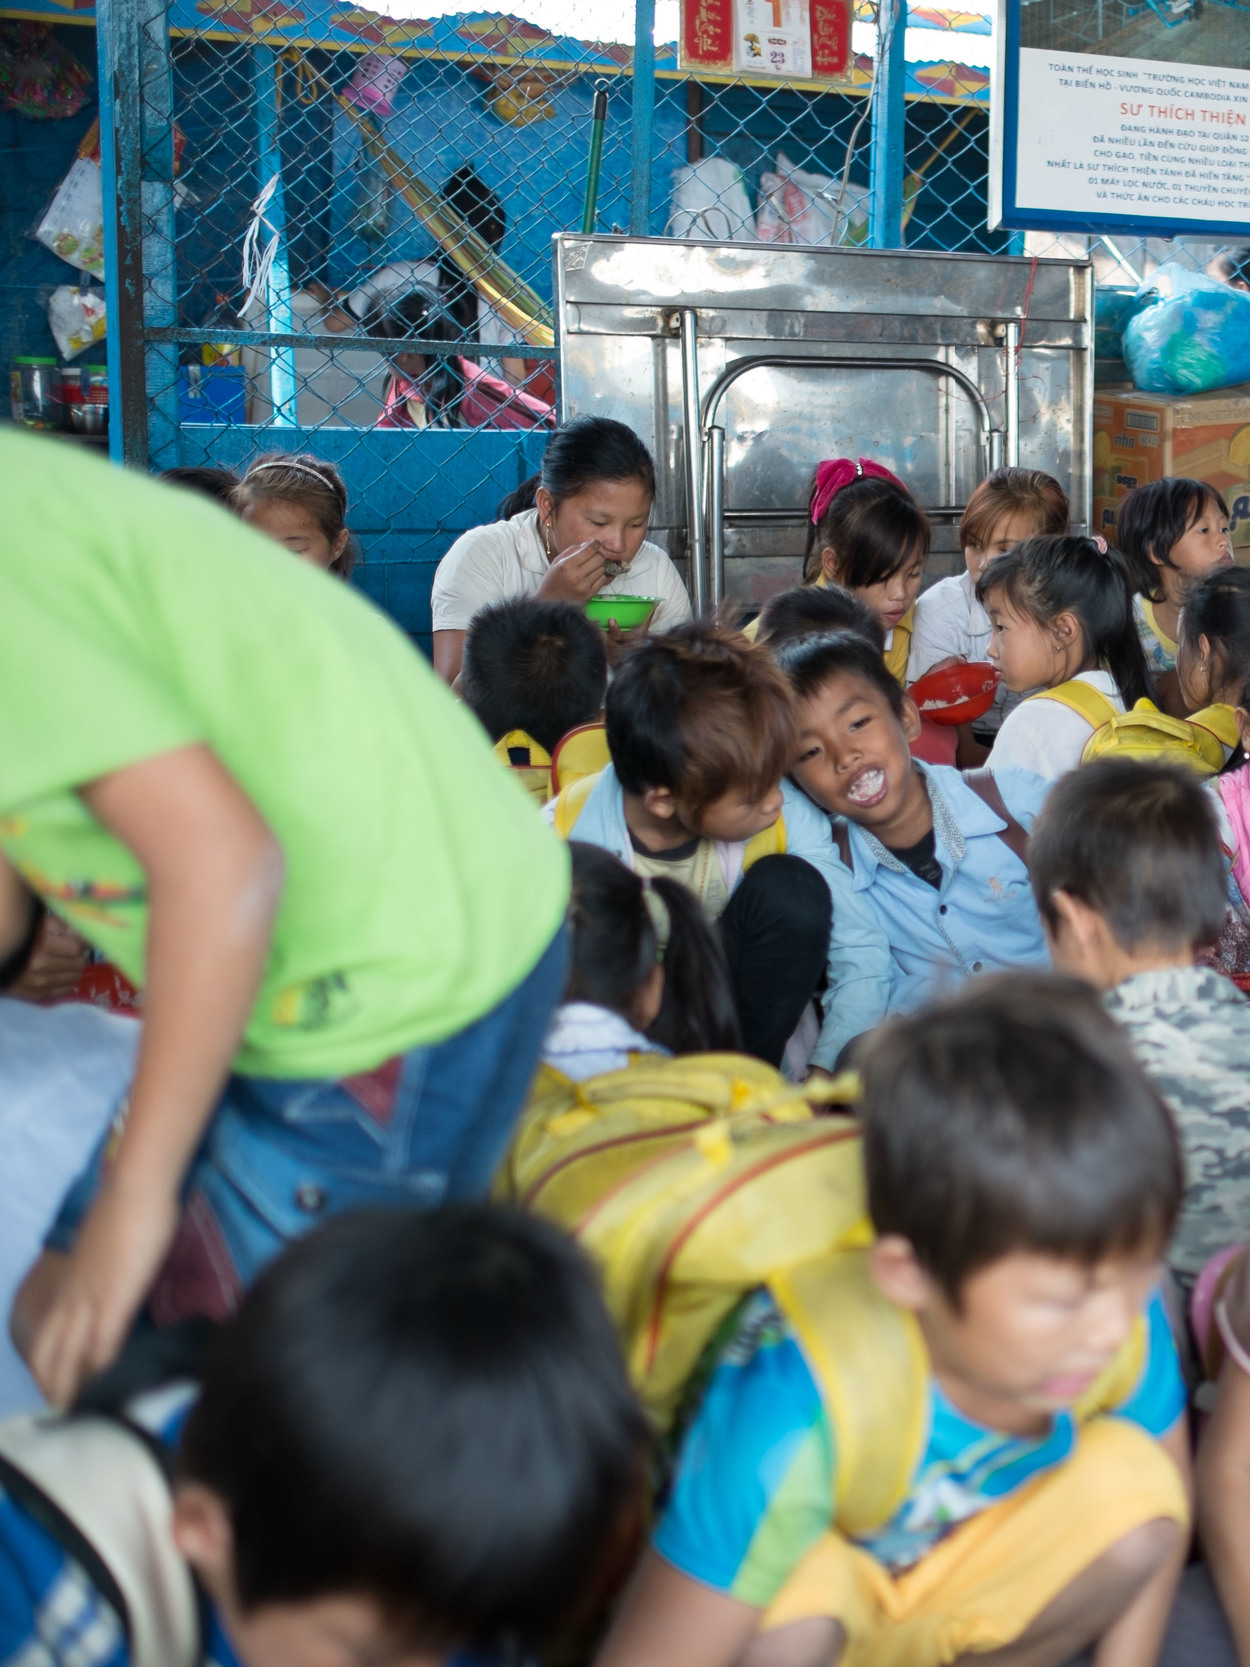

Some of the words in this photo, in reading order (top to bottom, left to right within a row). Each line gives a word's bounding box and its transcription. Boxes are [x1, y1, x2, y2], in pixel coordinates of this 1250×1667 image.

[770, 51, 785, 64] 23
[1120, 101, 1144, 117] SƯ
[1147, 101, 1196, 122] THÍCH
[1199, 106, 1247, 128] THIỆN
